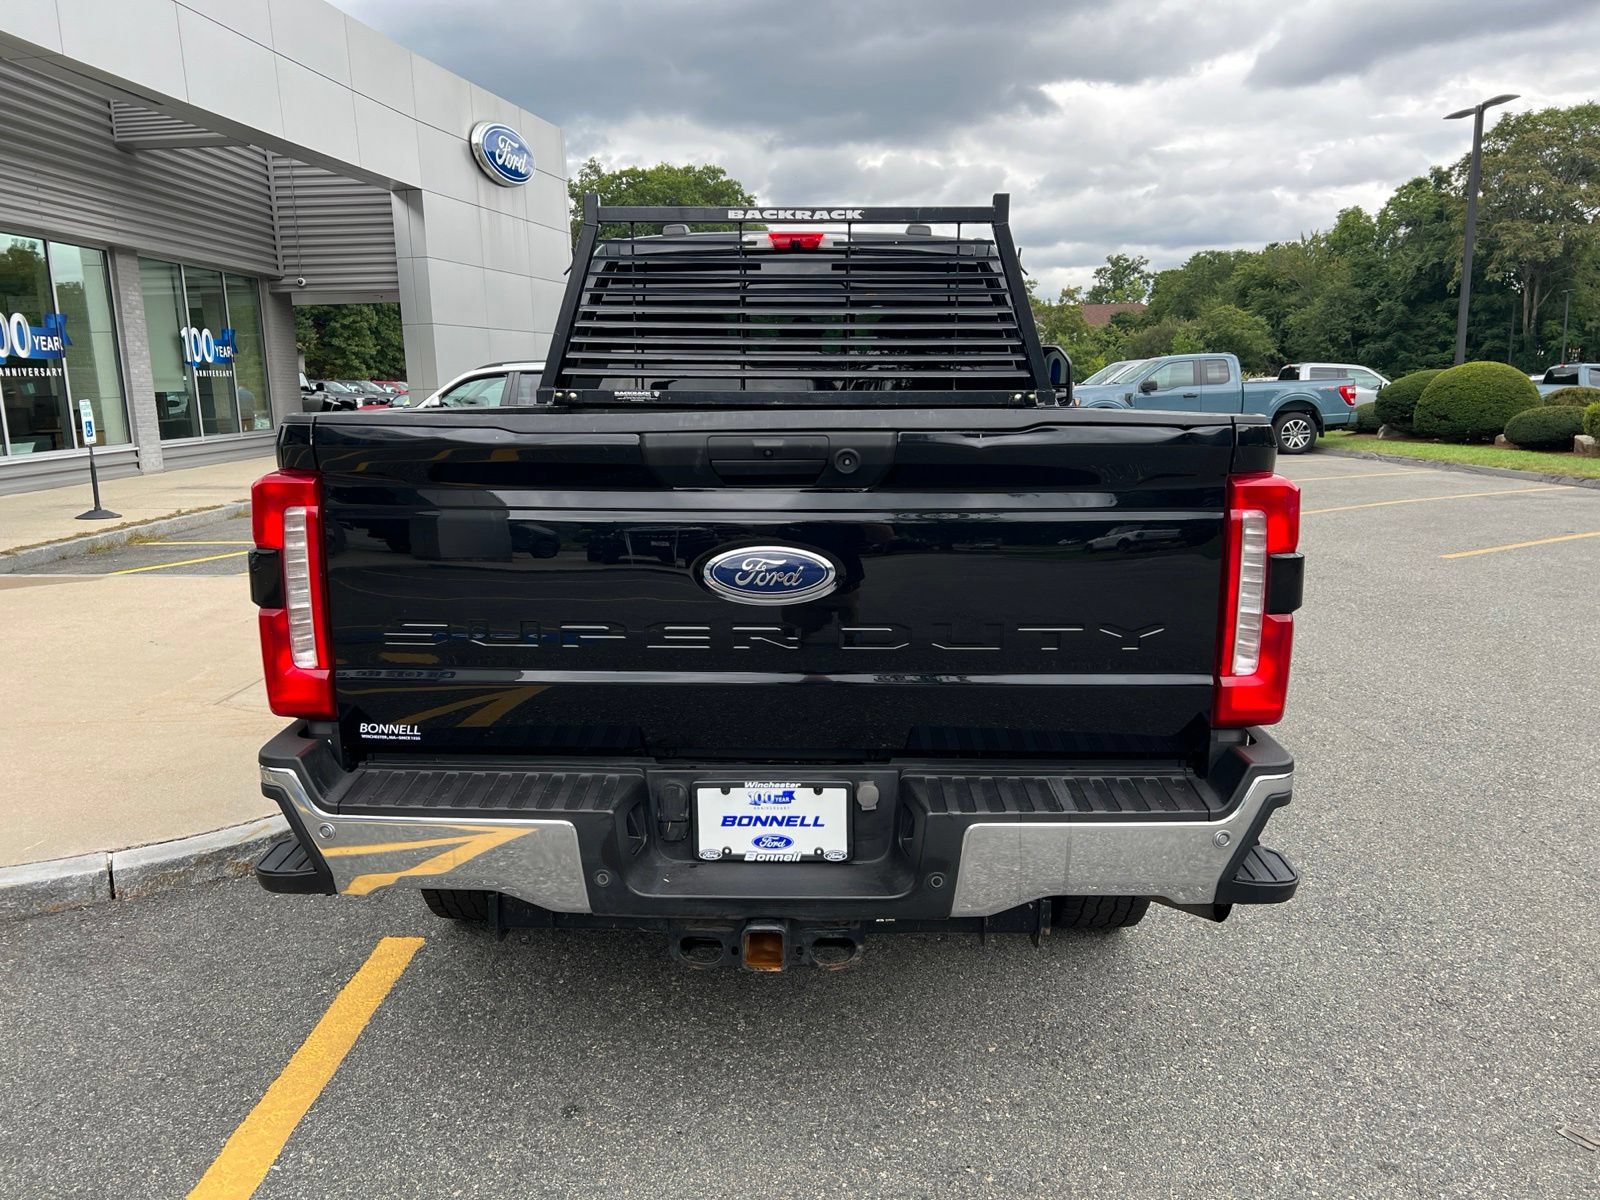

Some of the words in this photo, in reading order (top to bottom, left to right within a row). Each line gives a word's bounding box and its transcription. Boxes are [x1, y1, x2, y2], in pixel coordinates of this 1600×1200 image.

[495, 135, 527, 174] Ford
[727, 209, 863, 220] BACKRACK
[32, 335, 64, 351] YEAR
[180, 326, 215, 363] 100
[214, 345, 234, 358] YEAR
[0, 367, 63, 377] ANNIVERSARY
[195, 369, 233, 377] ANNIVERSARY
[734, 557, 804, 586] Ford
[383, 619, 800, 650] SUPER
[839, 621, 1167, 651] DUTY
[360, 723, 421, 735] BONNELL
[744, 781, 801, 789] Winchester
[747, 790, 774, 806] 100
[775, 796, 791, 804] YEAR
[721, 815, 825, 827] BONNELL
[759, 836, 786, 849] Ford
[744, 852, 801, 862] Bonnell
